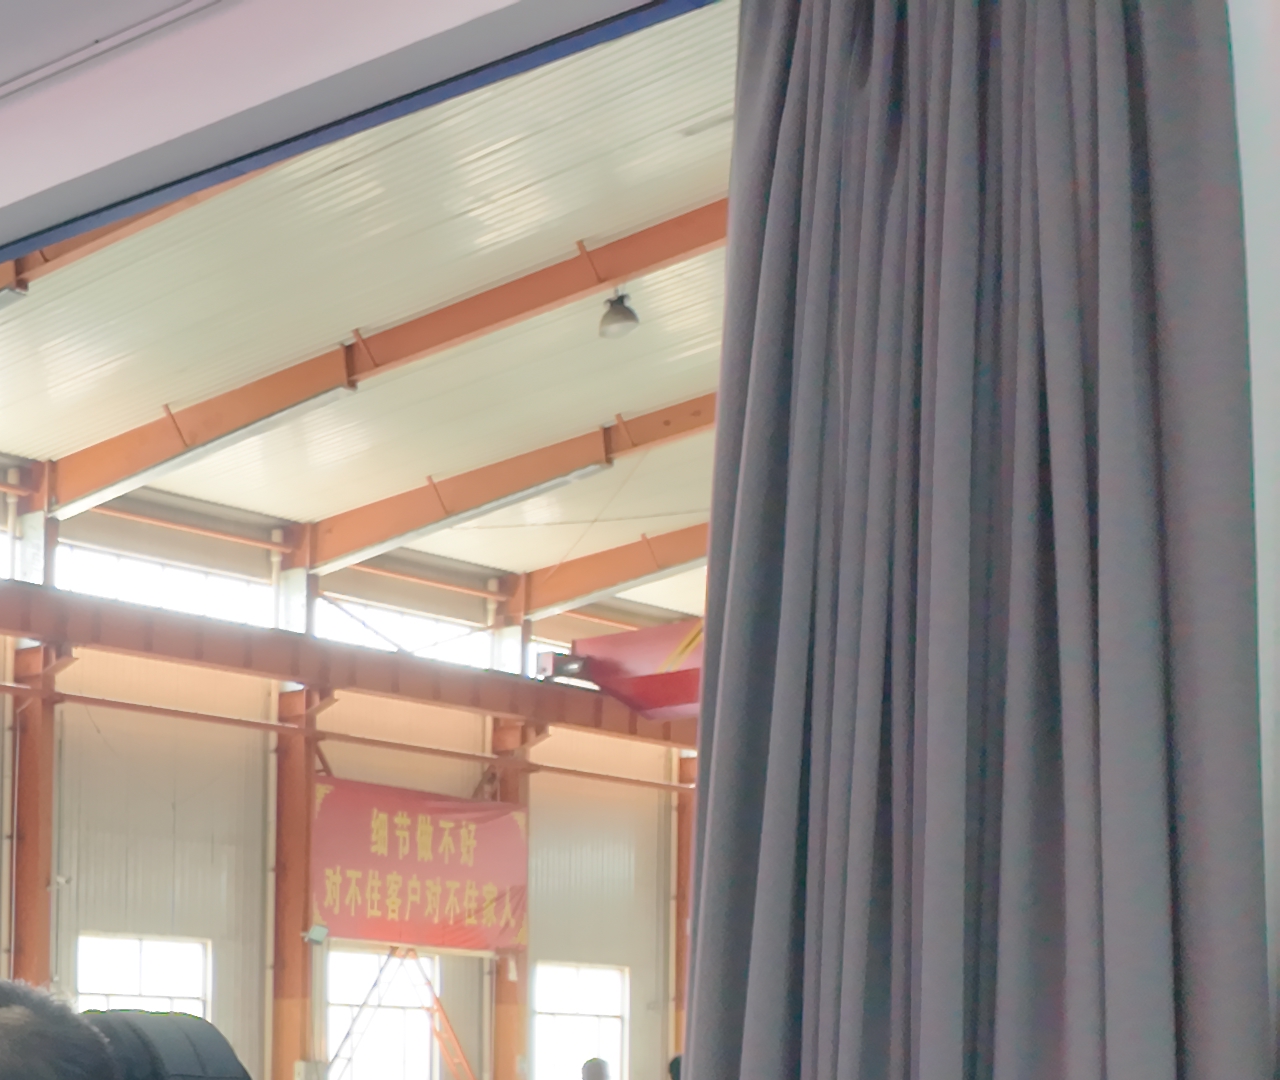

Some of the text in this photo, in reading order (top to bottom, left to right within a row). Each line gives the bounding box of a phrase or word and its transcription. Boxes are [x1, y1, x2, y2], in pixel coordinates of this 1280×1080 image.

[370, 808, 477, 867] 细节做不好
[324, 865, 515, 927] 对不住客户对不住家人
